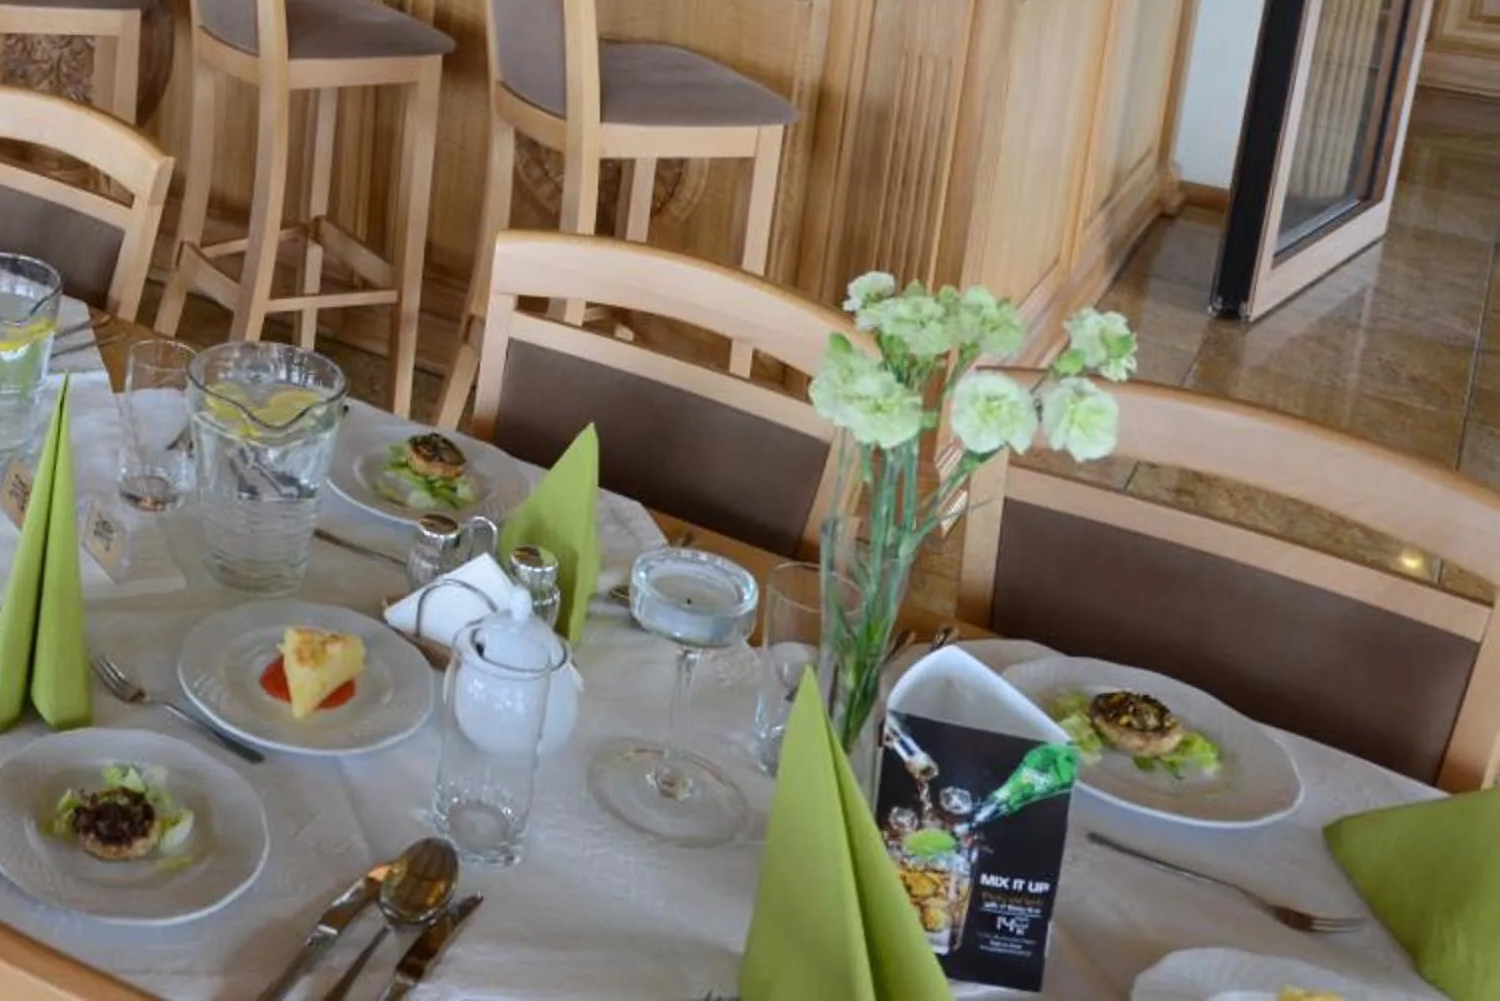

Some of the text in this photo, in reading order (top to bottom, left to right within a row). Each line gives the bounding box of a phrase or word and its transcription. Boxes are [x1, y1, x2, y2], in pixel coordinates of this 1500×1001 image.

[980, 873, 1051, 893] MIX IT UP
